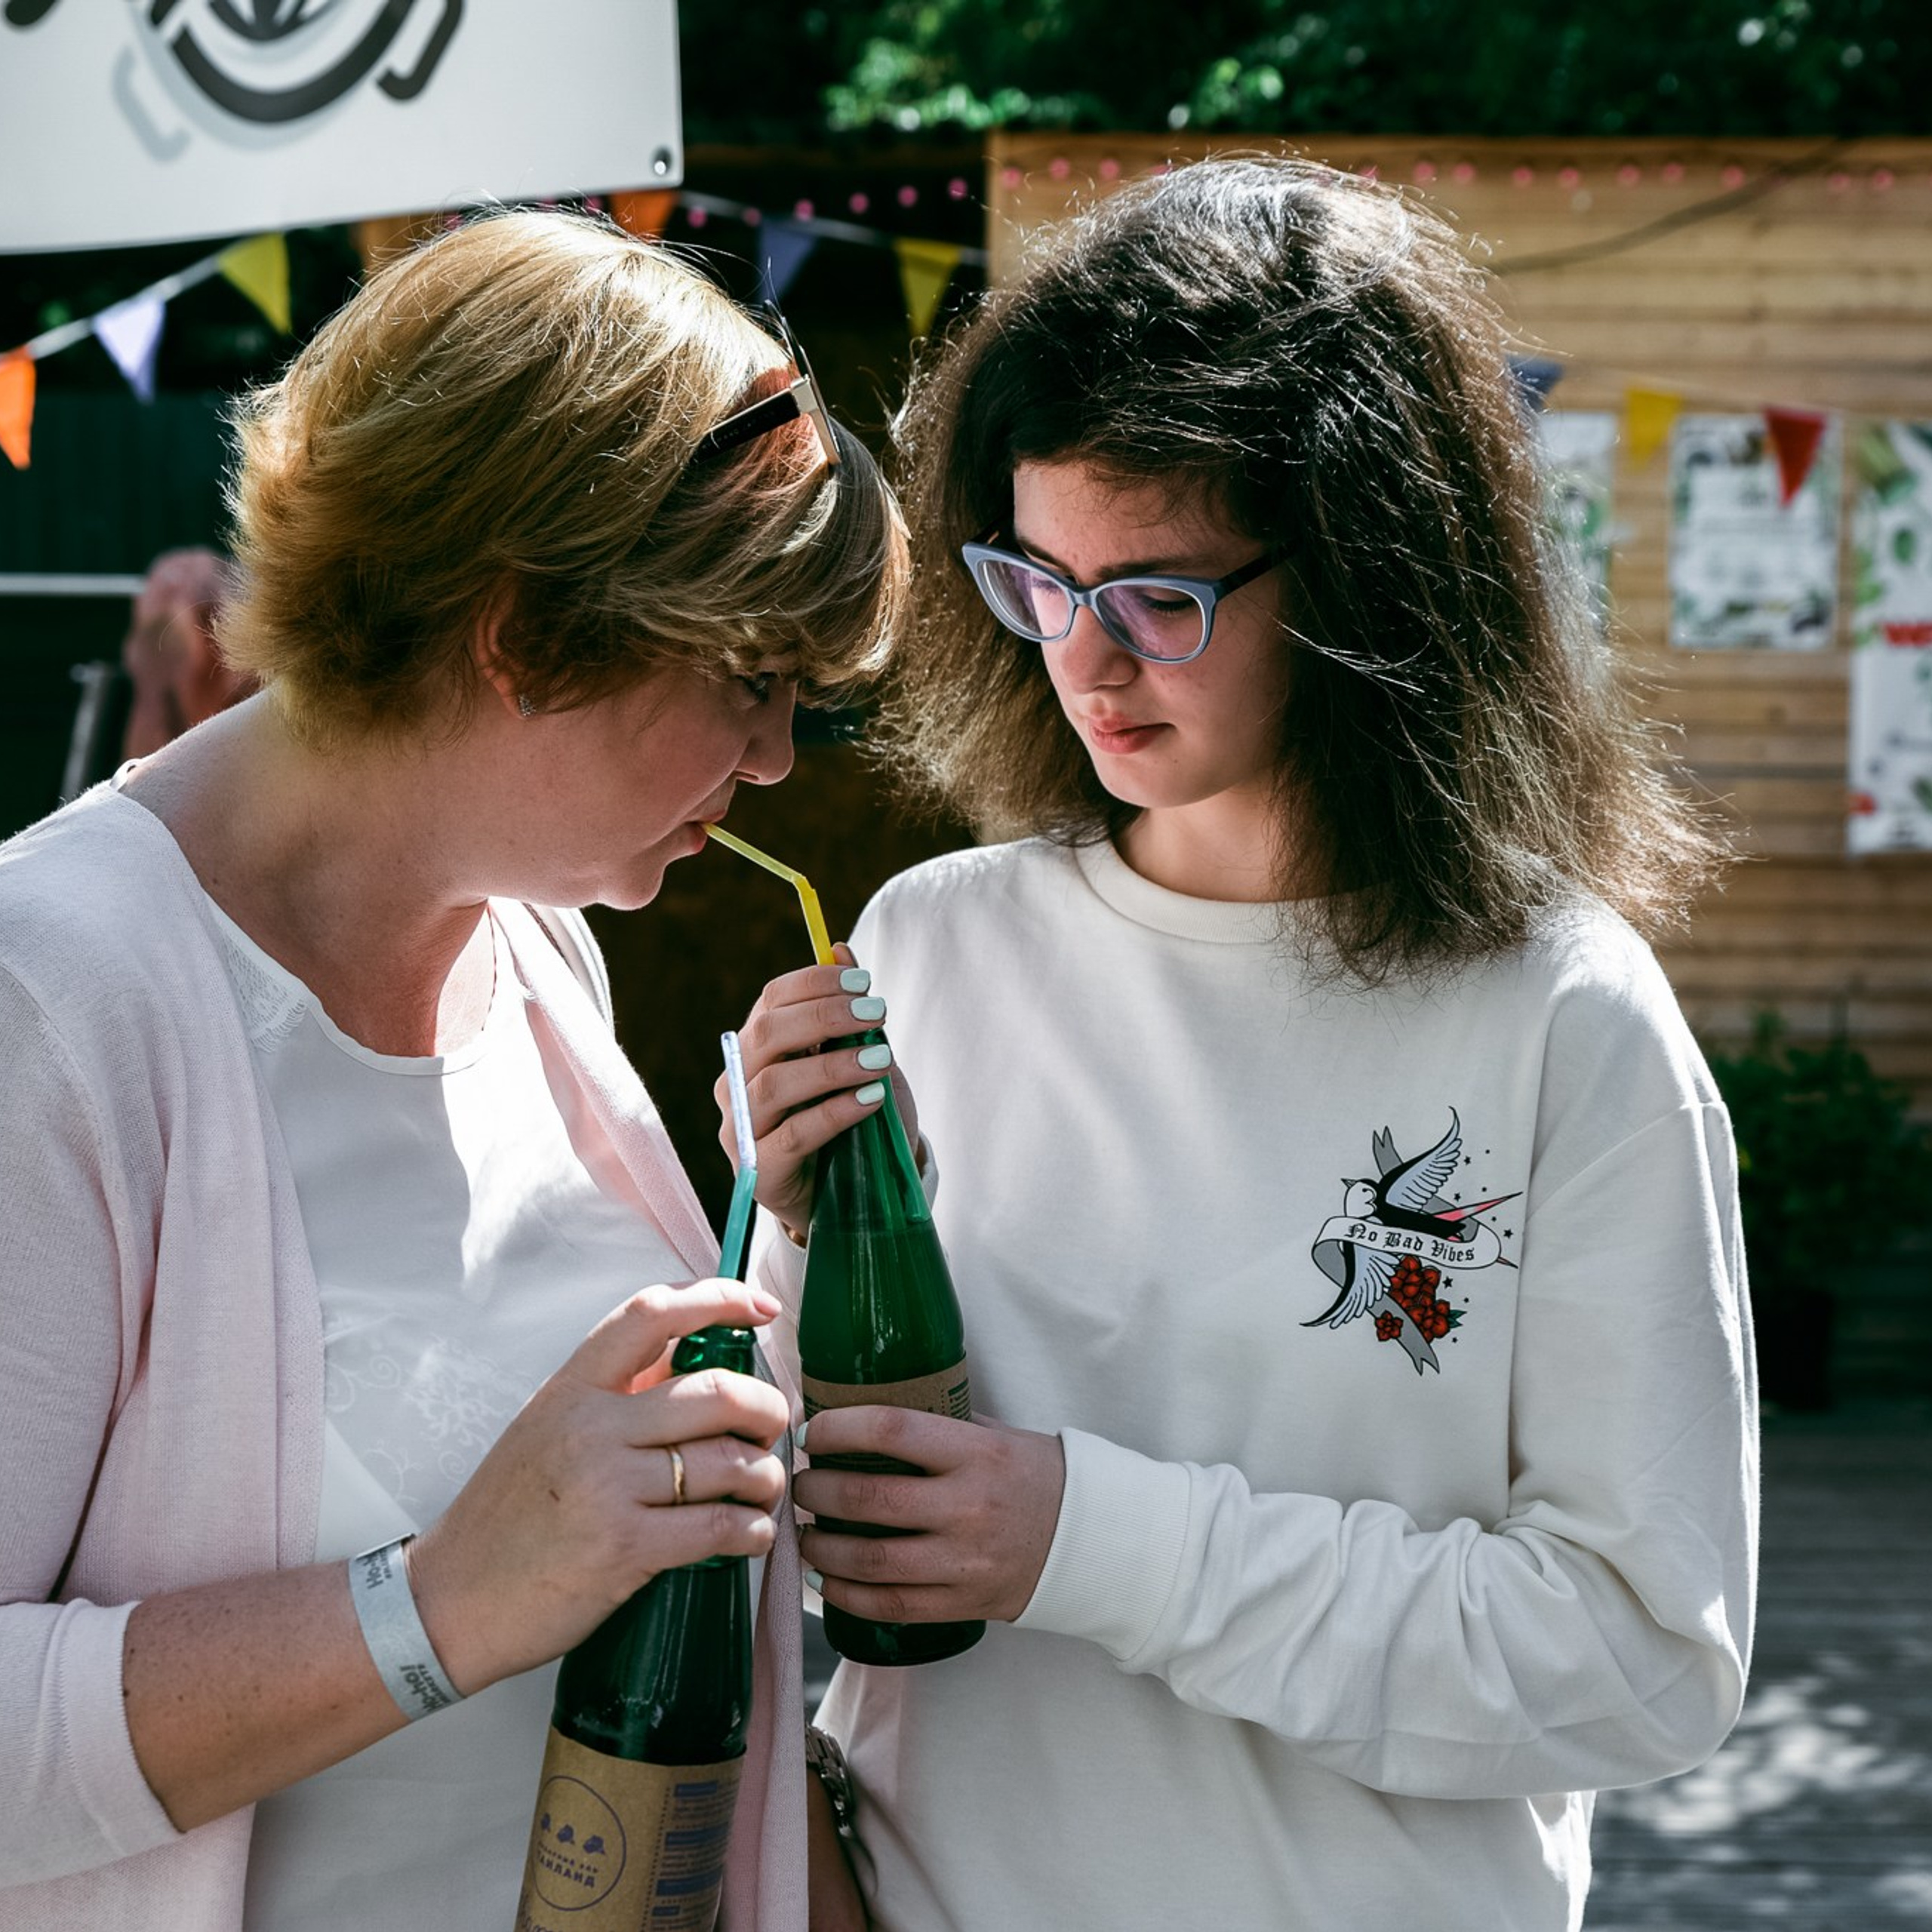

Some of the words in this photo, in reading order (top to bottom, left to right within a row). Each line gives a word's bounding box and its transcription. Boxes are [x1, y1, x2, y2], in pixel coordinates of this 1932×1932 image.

[1344, 1223, 1377, 1242] No
[1383, 1231, 1423, 1252] Bad
[1431, 1240, 1475, 1263] Vibes
